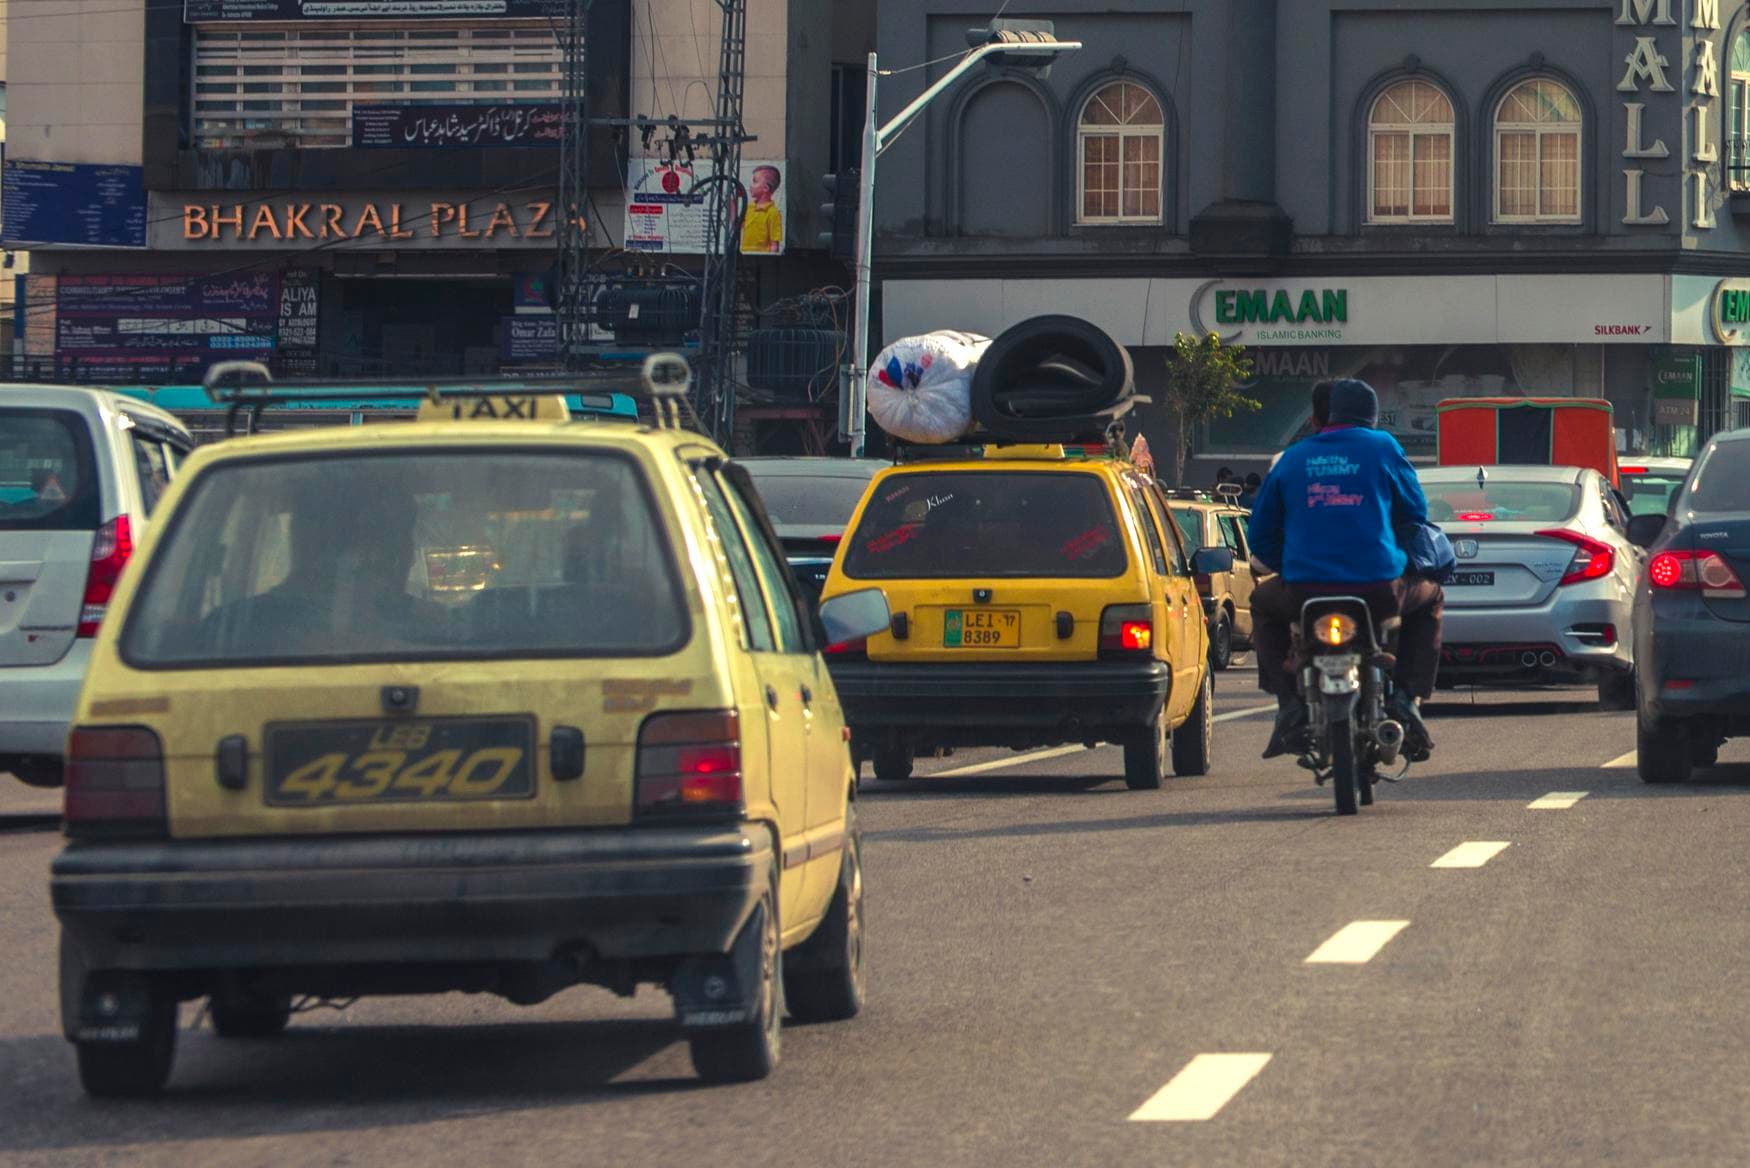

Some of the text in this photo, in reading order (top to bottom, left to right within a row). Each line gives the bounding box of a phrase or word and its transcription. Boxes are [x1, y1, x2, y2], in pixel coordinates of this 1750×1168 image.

[404, 116, 439, 143] عباس
[184, 203, 414, 241] BHAKRAL
[281, 287, 316, 302] ALIYA
[1215, 289, 1347, 324] EMAAN
[537, 328, 556, 338] Zafa
[1256, 329, 1343, 341] ISLAMIC BANKING
[1594, 325, 1641, 336] SILKBANK
[1255, 351, 1329, 377] MAAN
[1305, 463, 1361, 478] TUMMY
[1468, 574, 1490, 585] 002
[964, 629, 1001, 645] 8389
[281, 747, 523, 800] 4340
